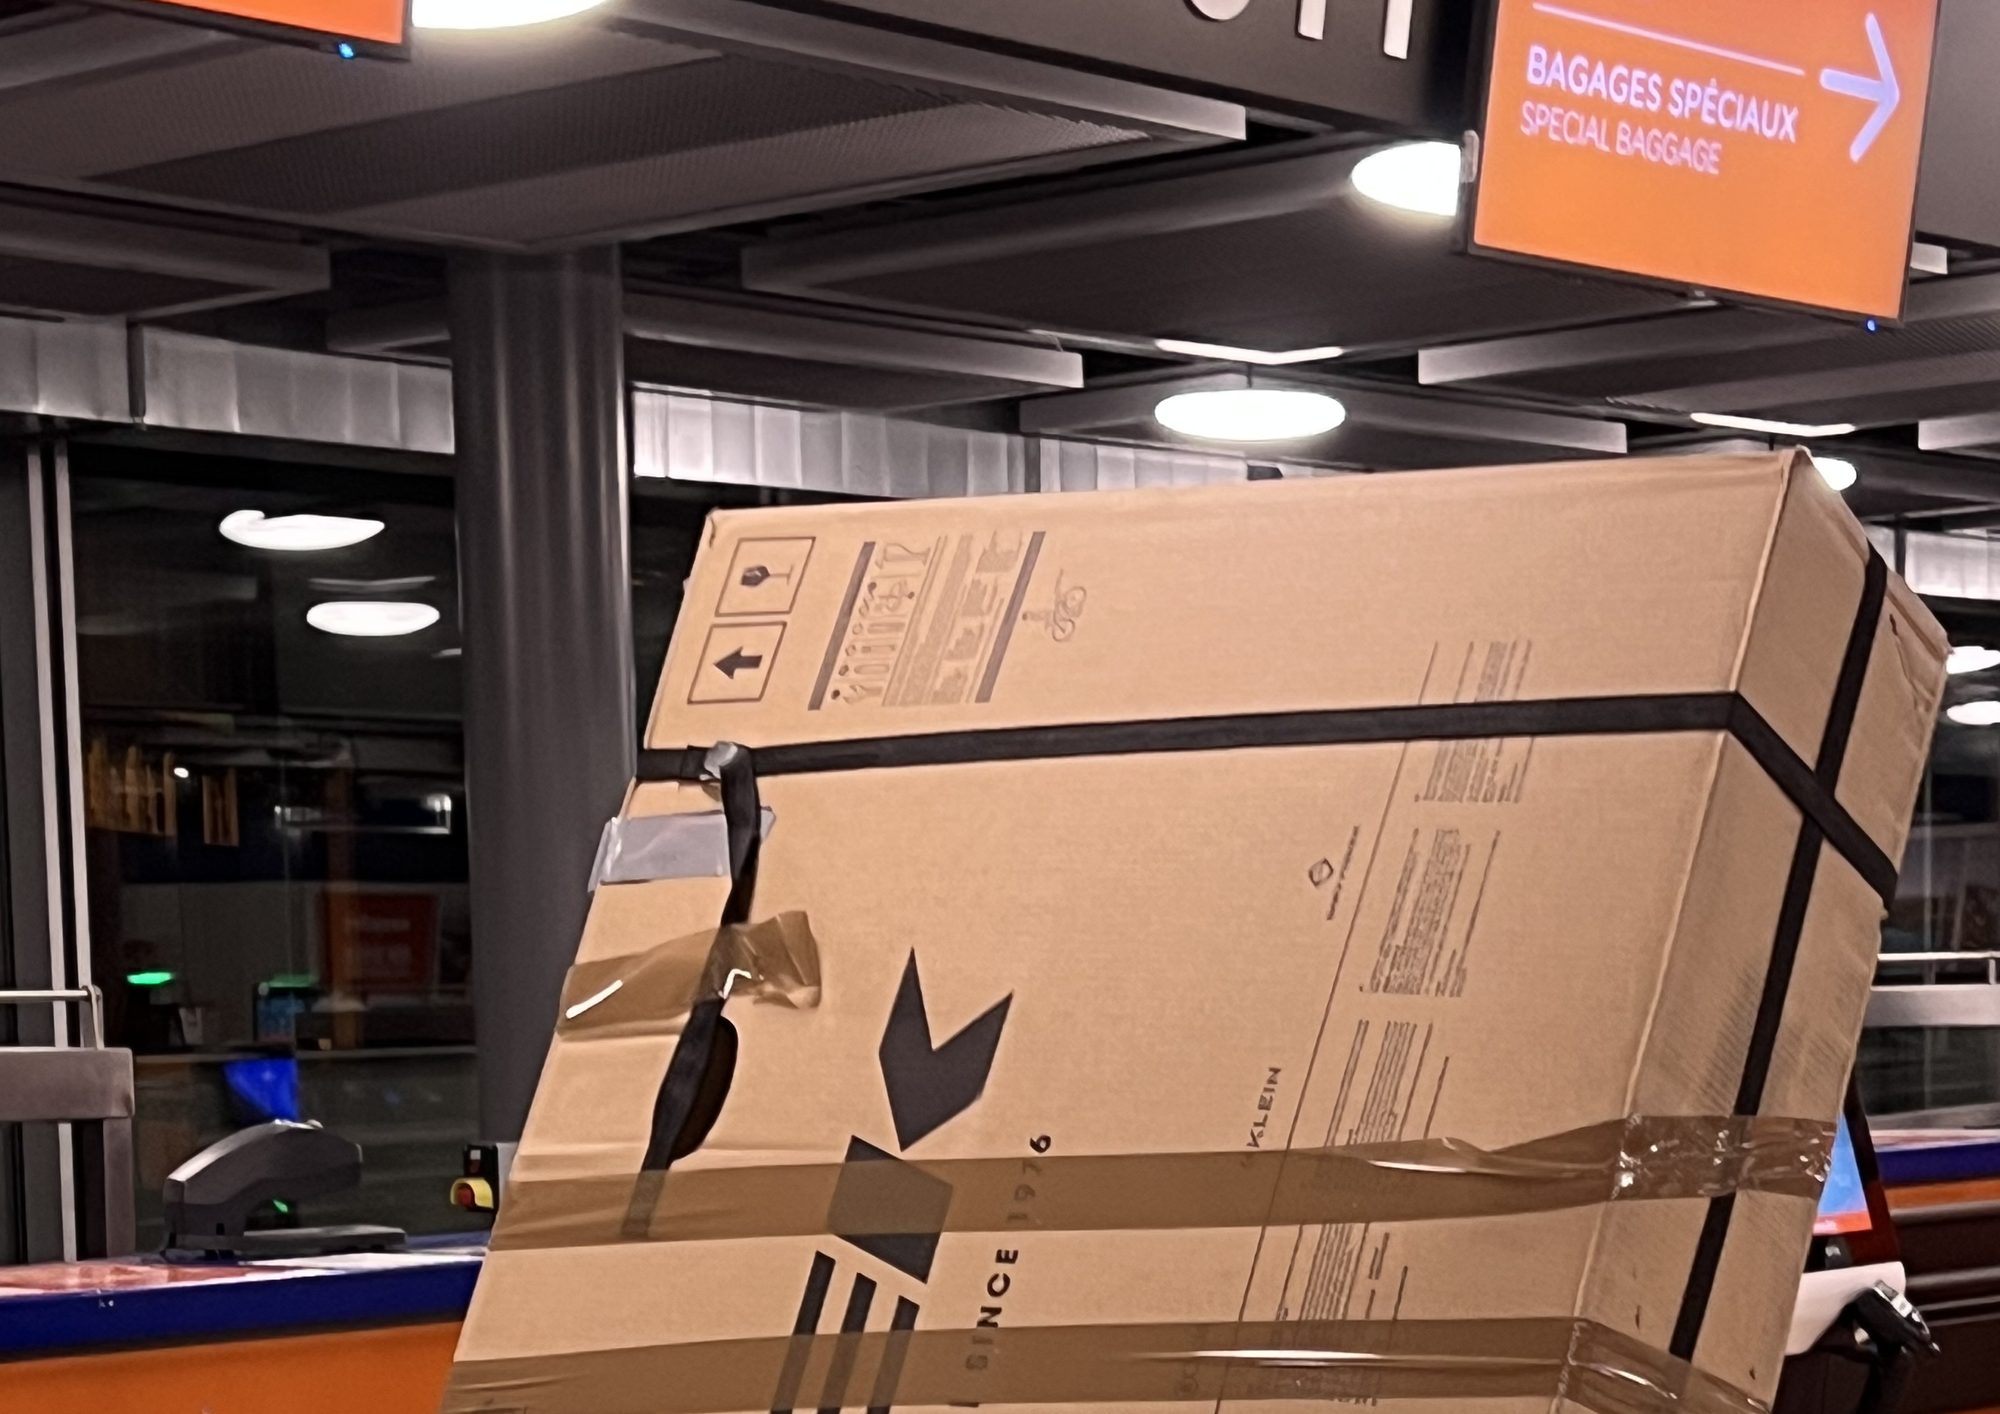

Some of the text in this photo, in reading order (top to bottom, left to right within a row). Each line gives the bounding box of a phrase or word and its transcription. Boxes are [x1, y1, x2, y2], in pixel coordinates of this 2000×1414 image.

[1519, 99, 1723, 175] SPECIAL BAGGAGE
[1526, 44, 1799, 143] BAGAGES SPÉCIAUX
[1246, 1065, 1282, 1149] KLEIN
[965, 1134, 1052, 1372] SINCE 1976
